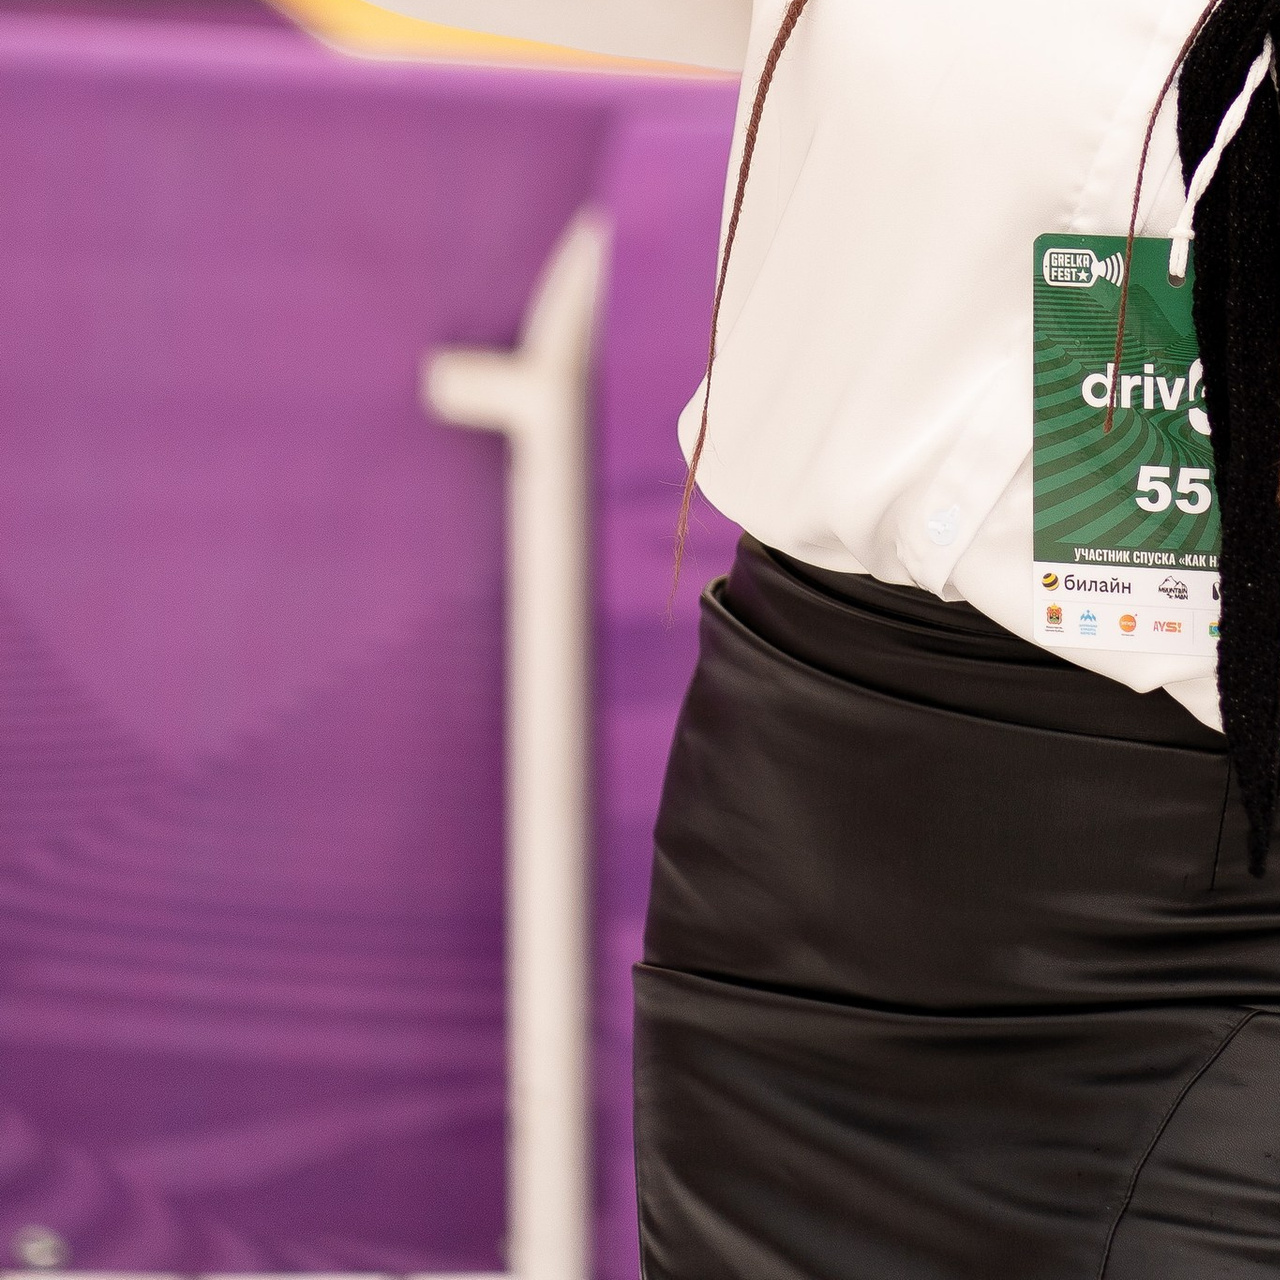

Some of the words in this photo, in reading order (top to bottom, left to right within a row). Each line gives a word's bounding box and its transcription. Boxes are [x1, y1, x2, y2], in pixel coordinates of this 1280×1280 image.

[1051, 253, 1090, 268] GRELKA
[1051, 267, 1077, 281] FEST
[1135, 465, 1212, 514] 55
[1074, 547, 1131, 563] УЧАСТНИК
[1133, 551, 1176, 566] СПУСКА
[1064, 574, 1132, 594] билайн
